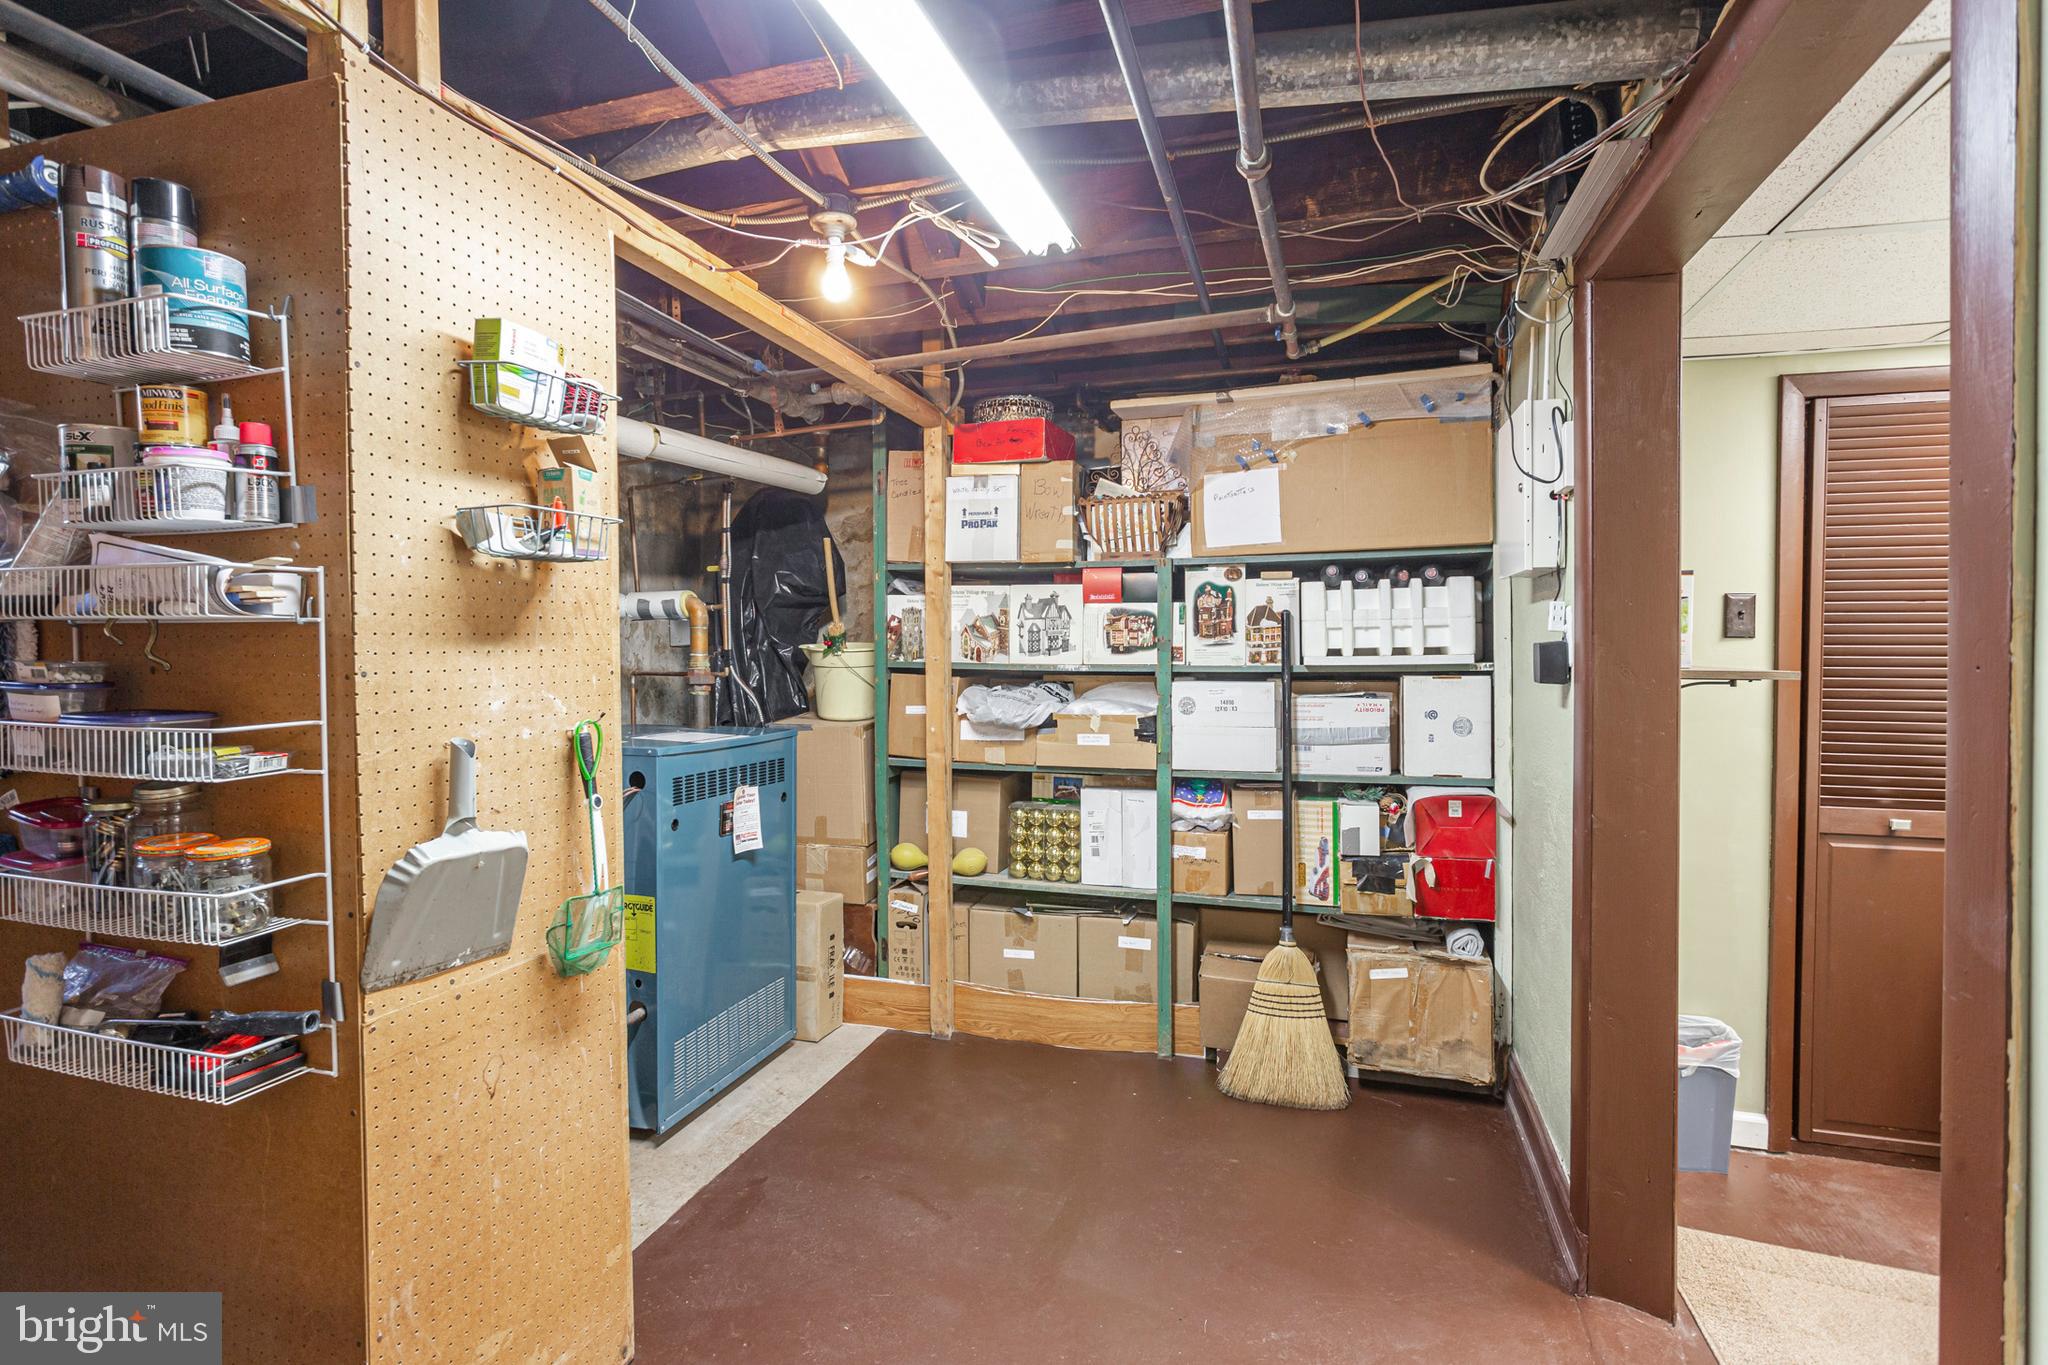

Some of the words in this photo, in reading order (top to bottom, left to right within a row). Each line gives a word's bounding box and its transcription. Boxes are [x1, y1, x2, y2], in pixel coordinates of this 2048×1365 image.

[172, 276, 190, 289] All
[193, 279, 245, 303] Surface
[142, 388, 180, 400] MINWAX
[1033, 478, 1065, 498] Bow
